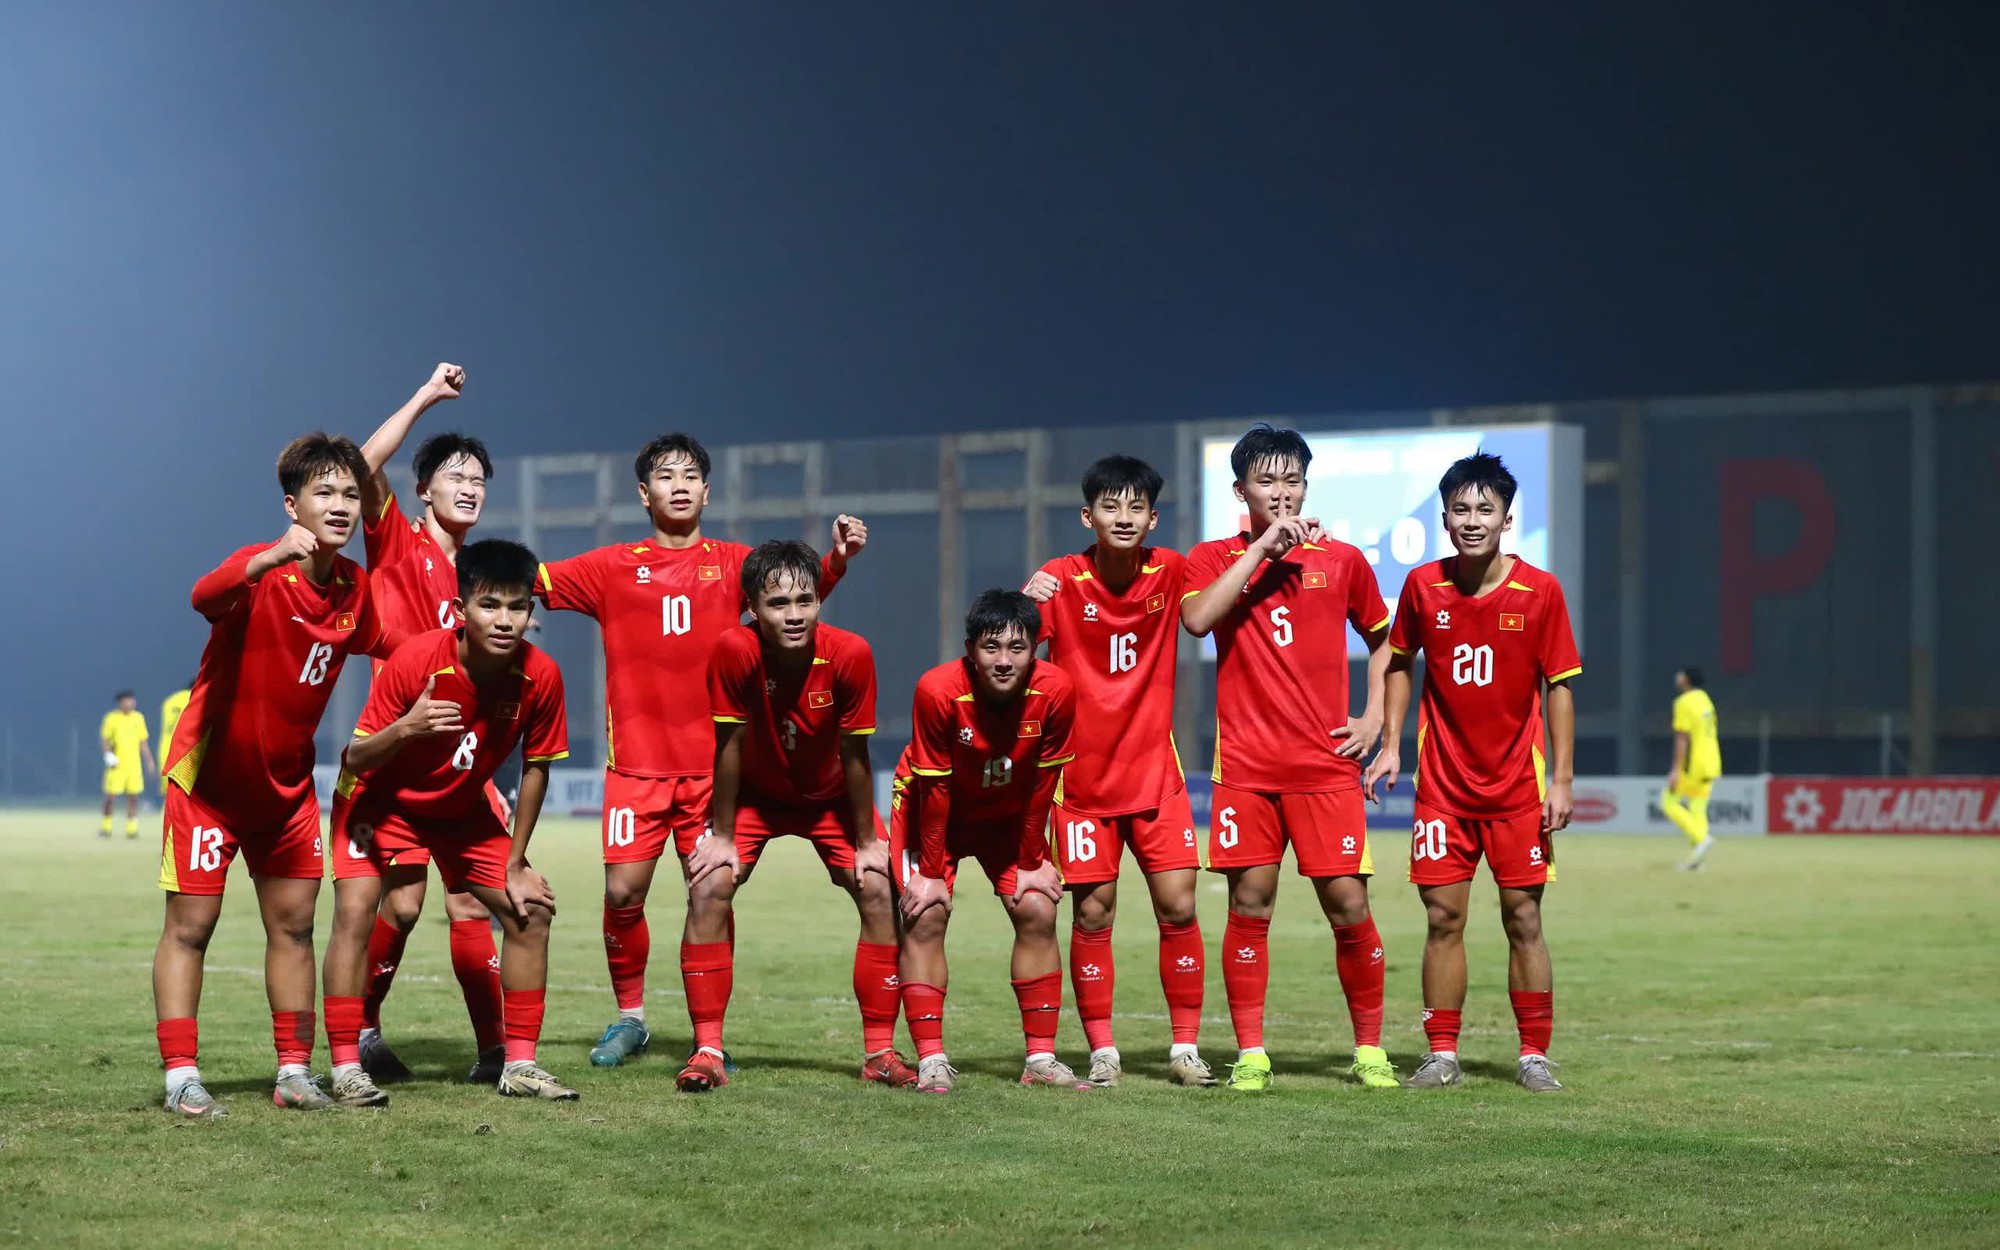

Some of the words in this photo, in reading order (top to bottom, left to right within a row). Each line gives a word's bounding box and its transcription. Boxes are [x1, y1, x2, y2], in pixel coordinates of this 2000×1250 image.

[1720, 457, 1837, 674] P
[662, 594, 692, 637] 10
[1270, 605, 1294, 648] 5
[299, 641, 333, 686] 13
[1110, 631, 1138, 674] 16
[1452, 642, 1494, 688] 20
[452, 731, 478, 771] 8
[982, 755, 1013, 788] 19
[607, 806, 635, 848] 10
[1067, 819, 1097, 863] 16
[1219, 806, 1239, 849] 5
[1413, 818, 1448, 862] 20
[189, 825, 224, 873] 13
